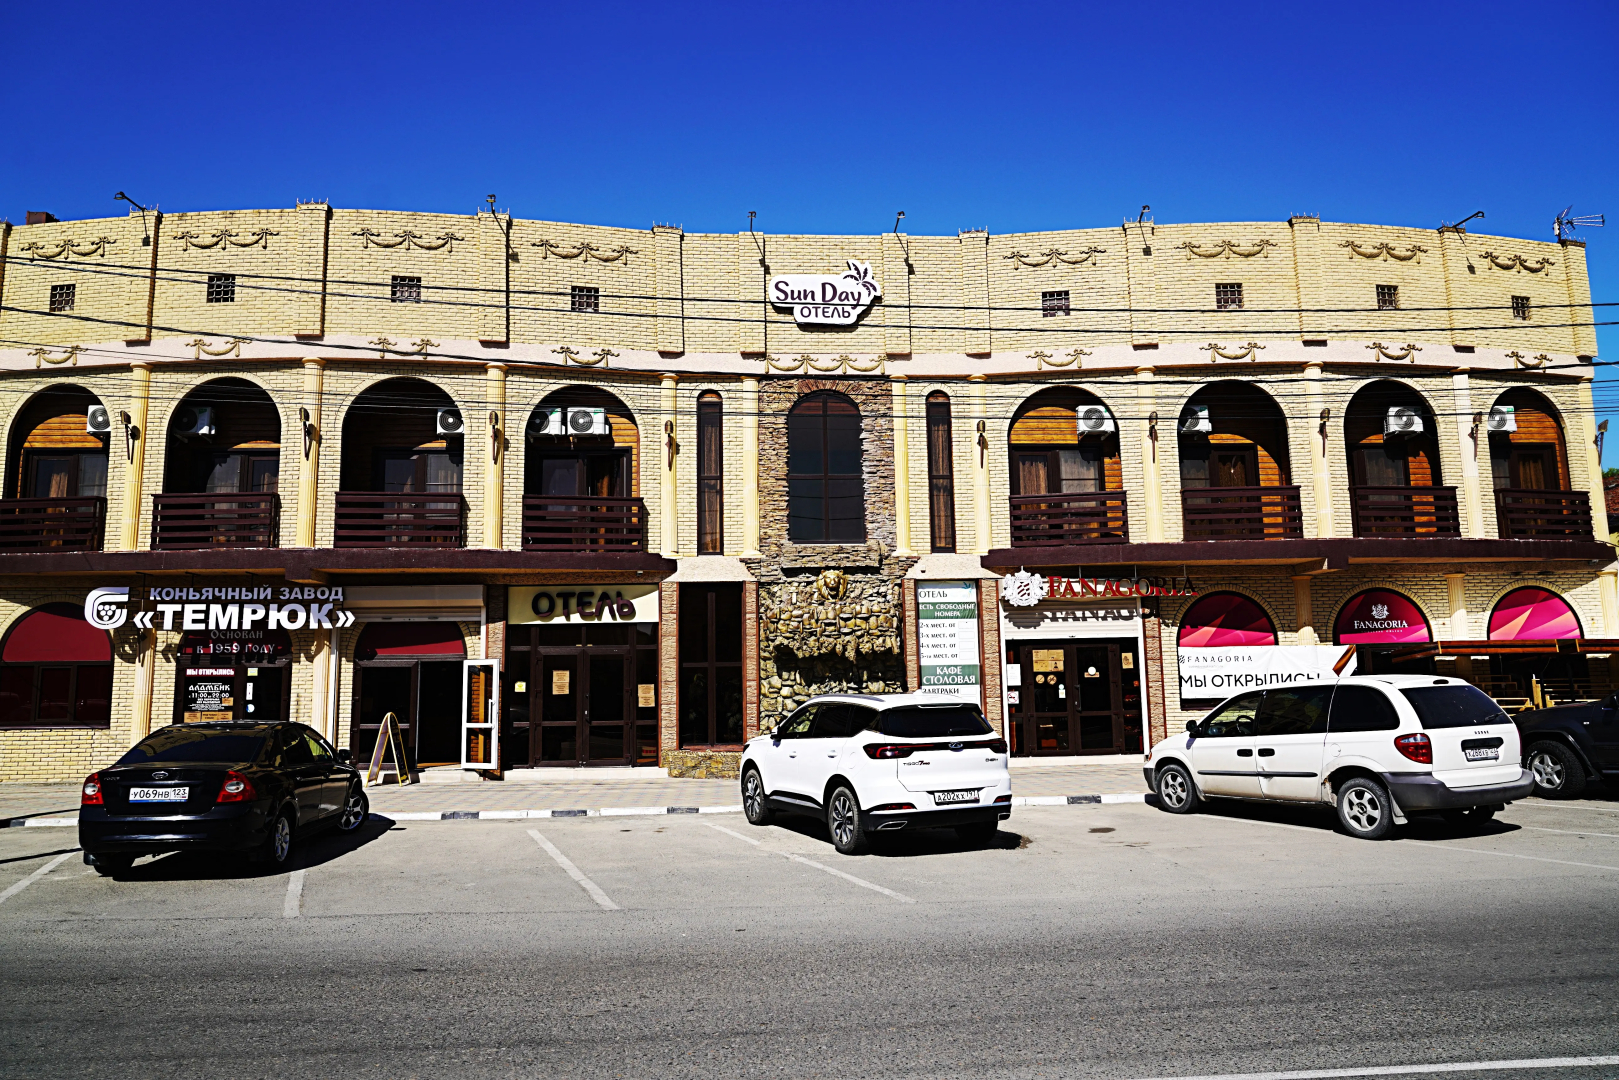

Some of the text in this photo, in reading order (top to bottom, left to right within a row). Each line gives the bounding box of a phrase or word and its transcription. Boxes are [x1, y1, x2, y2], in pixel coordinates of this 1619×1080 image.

[774, 280, 862, 310] Sun Day
[800, 306, 851, 319] ОТЕЛЬ
[1046, 576, 1199, 598] FANAGORIA
[149, 584, 344, 602] КОНЬЯЧНЫЙ ЗАВОД
[919, 590, 948, 598] ОТЕЛЬ
[531, 591, 635, 618] ОТЕЛЬ
[132, 603, 356, 630] «ТЕМРЮК»
[1354, 620, 1409, 629] FANAGORIA
[208, 644, 240, 653] 1959
[1187, 655, 1253, 663] FANAGORIA
[936, 666, 962, 675] КАФЕ
[923, 676, 976, 684] СТОЛОВАЯ
[1180, 674, 1207, 688] МЫ
[172, 788, 187, 796] 123
